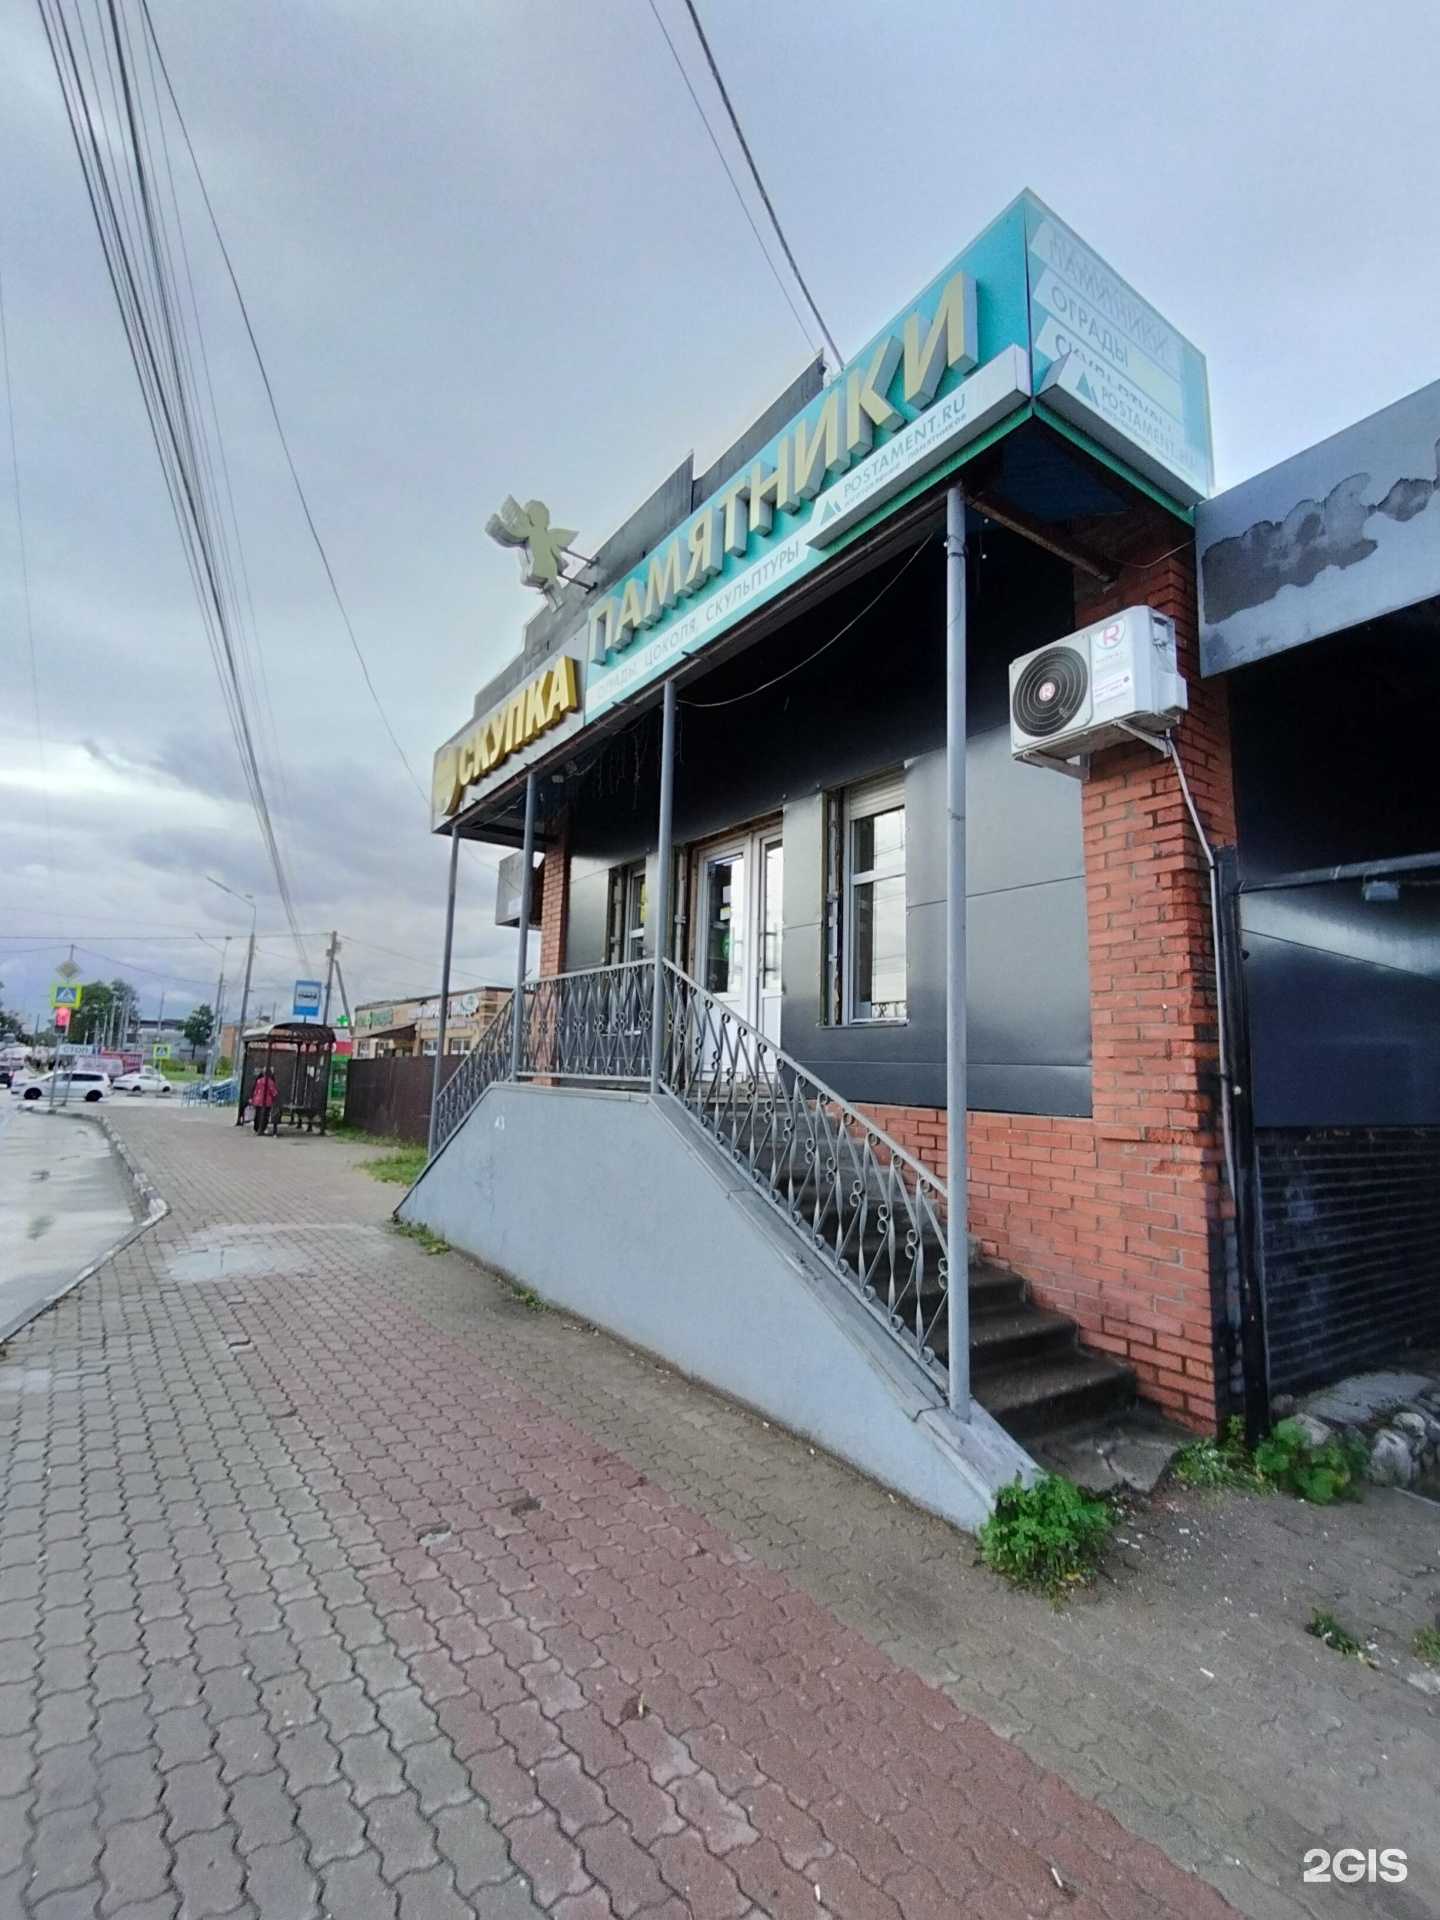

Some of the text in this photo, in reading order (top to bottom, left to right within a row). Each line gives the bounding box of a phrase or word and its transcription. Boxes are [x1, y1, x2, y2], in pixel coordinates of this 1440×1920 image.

[1051, 285, 1129, 368] ОГРАДЫ
[588, 271, 977, 666] ПАМЯТНИКИ
[843, 394, 967, 498] POSTAMENT.RU
[704, 540, 800, 623] СКУЛЬПТУРЫ
[457, 655, 578, 787] СКУПКА
